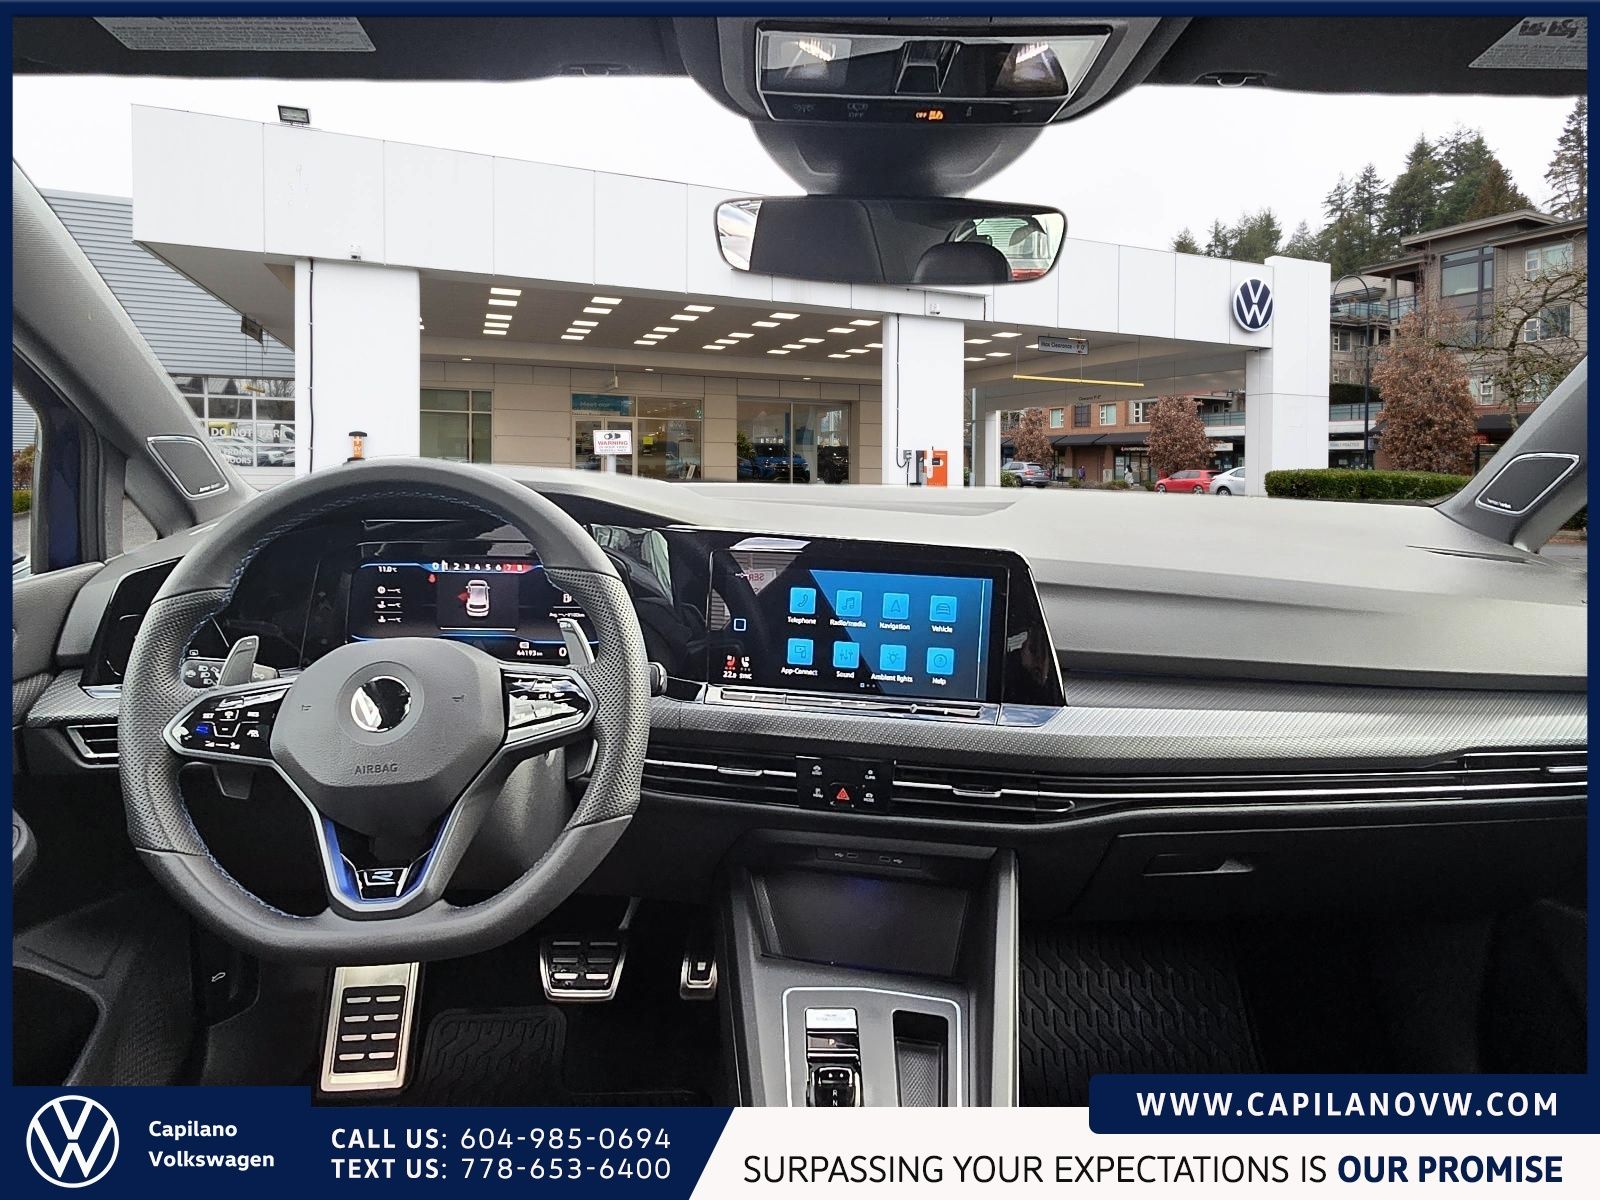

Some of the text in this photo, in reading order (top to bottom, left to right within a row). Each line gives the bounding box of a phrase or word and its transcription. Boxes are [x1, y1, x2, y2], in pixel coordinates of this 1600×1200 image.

[1233, 277, 1273, 331] VW
[211, 427, 227, 437] DO
[230, 428, 253, 437] NOT
[452, 562, 460, 571] 2
[463, 562, 471, 571] 3
[474, 562, 481, 571] 4
[485, 562, 492, 571] 5
[495, 562, 502, 571] 6
[787, 616, 817, 625] Telephone
[829, 619, 867, 628] Radio/media
[879, 622, 911, 631] Navigation
[931, 625, 953, 633] Vehicle
[781, 667, 818, 676] App-Connect
[836, 671, 855, 679] Sound
[871, 673, 913, 684] Ambient lights
[932, 677, 947, 686] Help
[354, 763, 398, 775] AIRBAG
